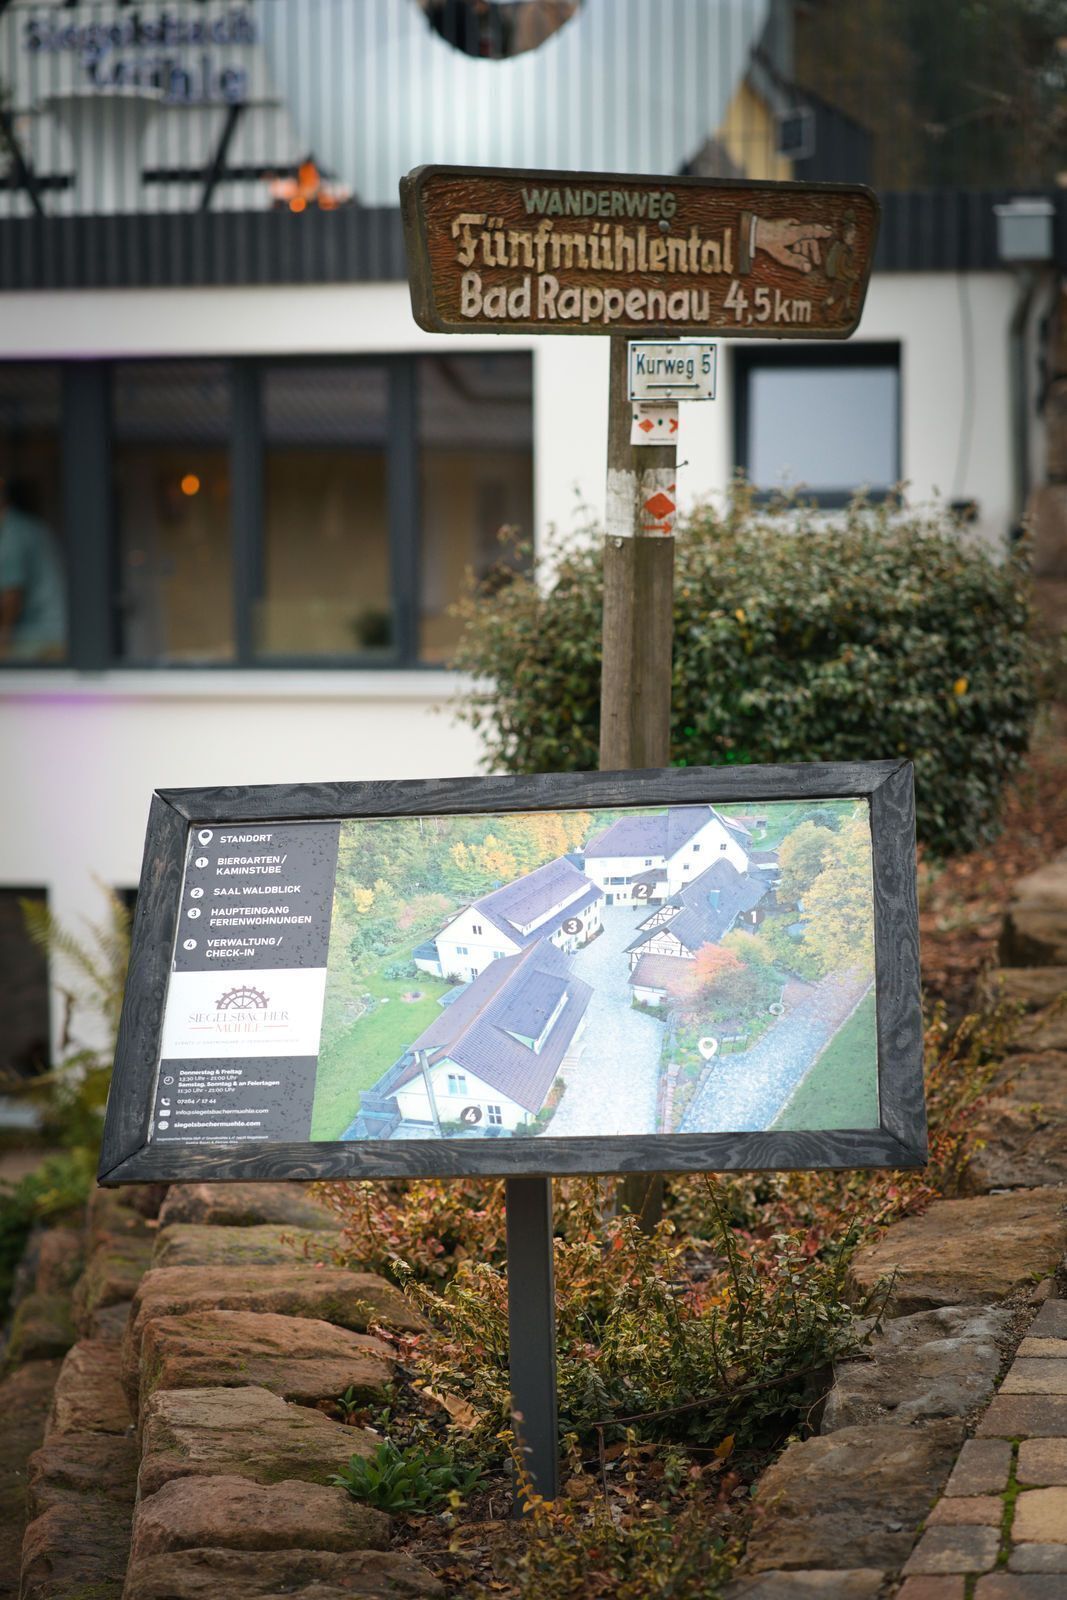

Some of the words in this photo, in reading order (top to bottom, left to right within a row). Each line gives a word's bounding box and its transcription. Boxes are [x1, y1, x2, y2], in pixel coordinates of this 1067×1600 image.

[521, 187, 677, 218] WANDERWEG
[451, 212, 732, 275] Fünfmühlental
[460, 271, 531, 319] Bad
[538, 274, 710, 324] Rappenau
[636, 353, 695, 380] Kurweg
[701, 353, 711, 375] 5
[220, 834, 272, 844] STANDORT
[216, 866, 282, 875] KAMINSTUBE
[213, 887, 240, 896] SAAL
[242, 885, 301, 895] WALDBLICK
[638, 885, 648, 897] 2
[211, 906, 290, 916] HAUPTEINGANG
[210, 915, 312, 926] FERIENWOHNUNGEN
[567, 920, 578, 933] 3
[205, 948, 255, 958] CHECK-IN
[221, 1068, 243, 1076] Freitag
[465, 1108, 477, 1122] 4
